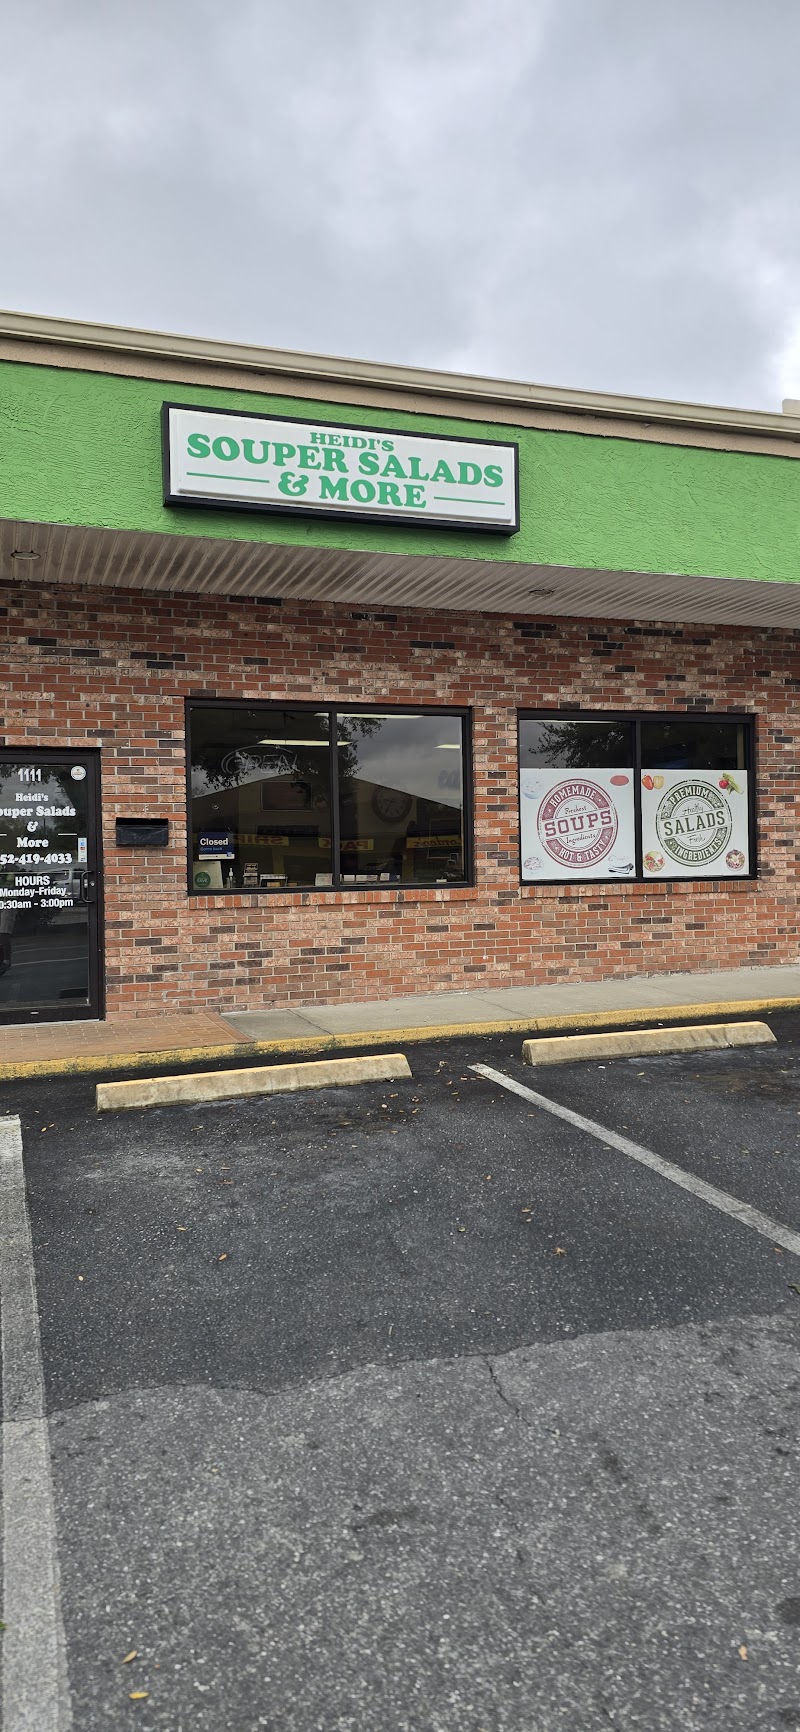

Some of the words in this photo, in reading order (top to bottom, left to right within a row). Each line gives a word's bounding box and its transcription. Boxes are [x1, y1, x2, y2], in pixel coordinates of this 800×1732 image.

[309, 432, 395, 452] HEIDI'S
[186, 433, 349, 474] SOUPER
[358, 453, 504, 488] SALADS
[277, 471, 310, 497] &
[318, 475, 428, 509] MORE
[17, 768, 42, 782] 1111
[15, 792, 49, 802] Heidi's
[549, 785, 597, 808] HOMEMADE
[669, 785, 711, 805] PREMIUM
[35, 805, 76, 817] Salads
[26, 821, 39, 832] &
[544, 809, 612, 837] SOUPS
[663, 810, 726, 836] SALADS
[16, 836, 49, 848] More
[199, 837, 229, 846] Closed
[558, 846, 575, 861] HOT
[576, 851, 582, 861] &
[584, 839, 607, 860] TASTY
[674, 838, 722, 861] INGREDIENTS
[0, 852, 73, 866] 52-419-4033
[15, 875, 50, 887] HOURS
[0, 886, 67, 898] Monday-Friday
[40, 898, 74, 909] 3:00pm
